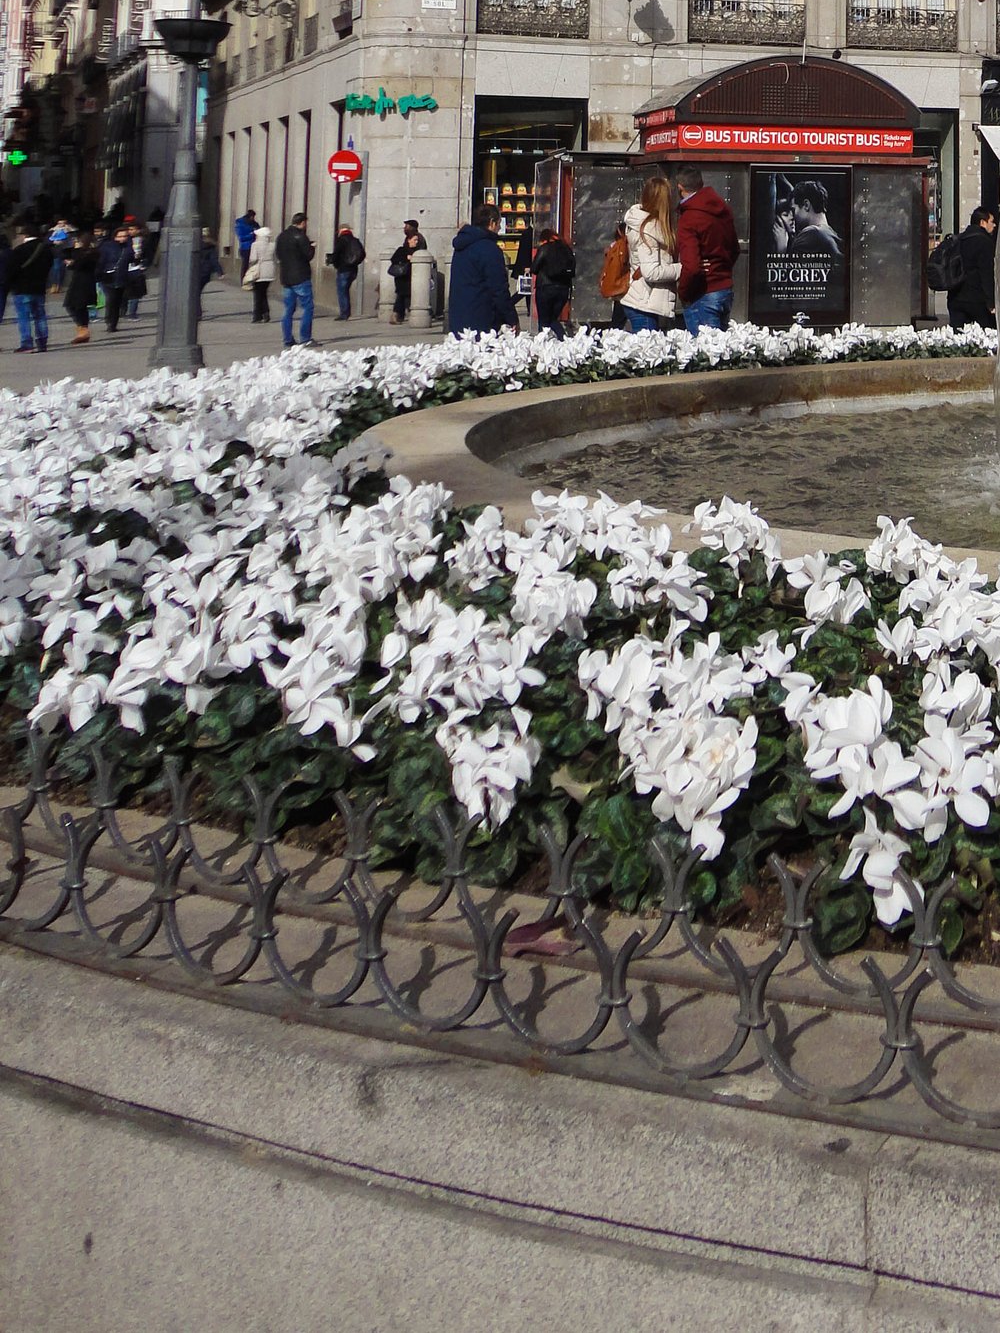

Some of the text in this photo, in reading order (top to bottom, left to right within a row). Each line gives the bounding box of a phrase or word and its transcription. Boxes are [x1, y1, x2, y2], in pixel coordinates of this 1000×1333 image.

[705, 128, 881, 147] BUS TURÍSTICO TOURIST BUS
[768, 268, 831, 283] DE GREY
